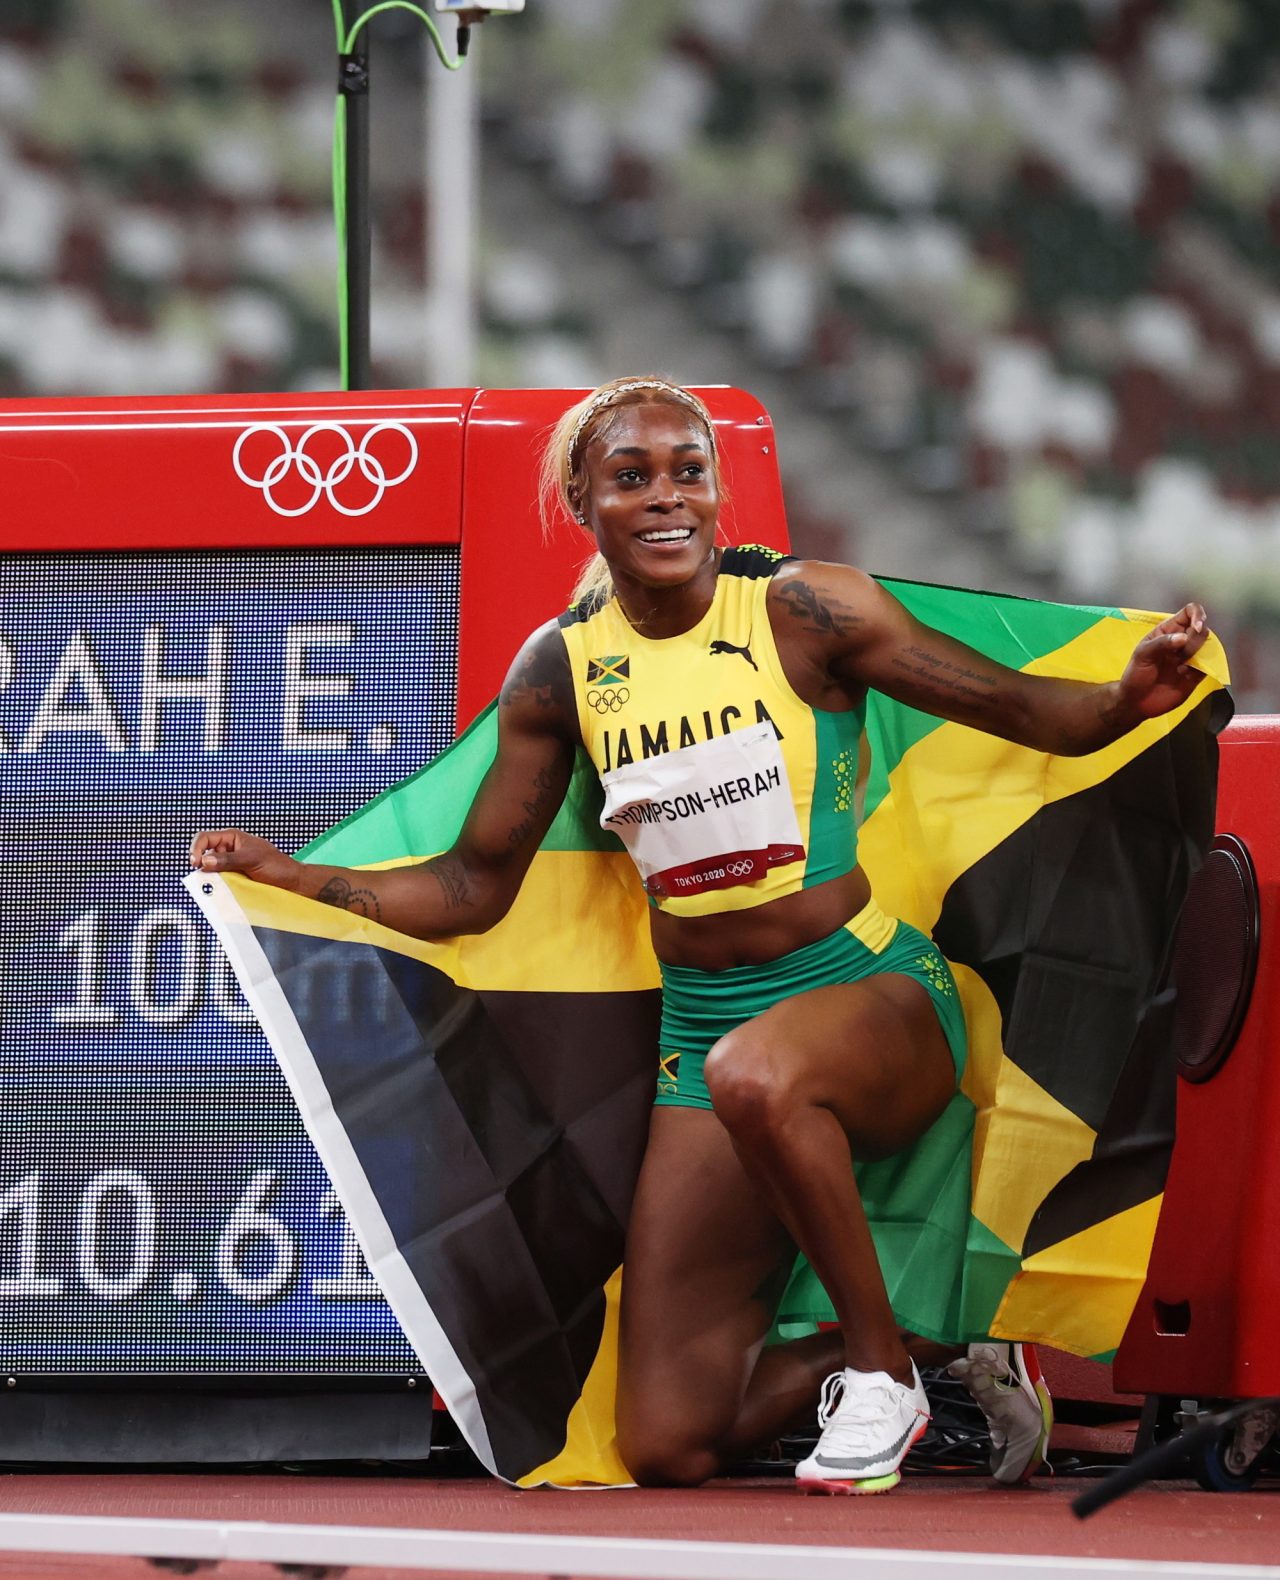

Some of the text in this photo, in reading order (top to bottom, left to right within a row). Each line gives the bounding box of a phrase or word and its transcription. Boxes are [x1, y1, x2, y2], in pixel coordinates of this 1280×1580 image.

[281, 620, 396, 754] E.
[603, 699, 784, 774] JAMAICA
[605, 766, 781, 826] THOMPSON-HERAH
[674, 868, 726, 888] TOKYO 2020
